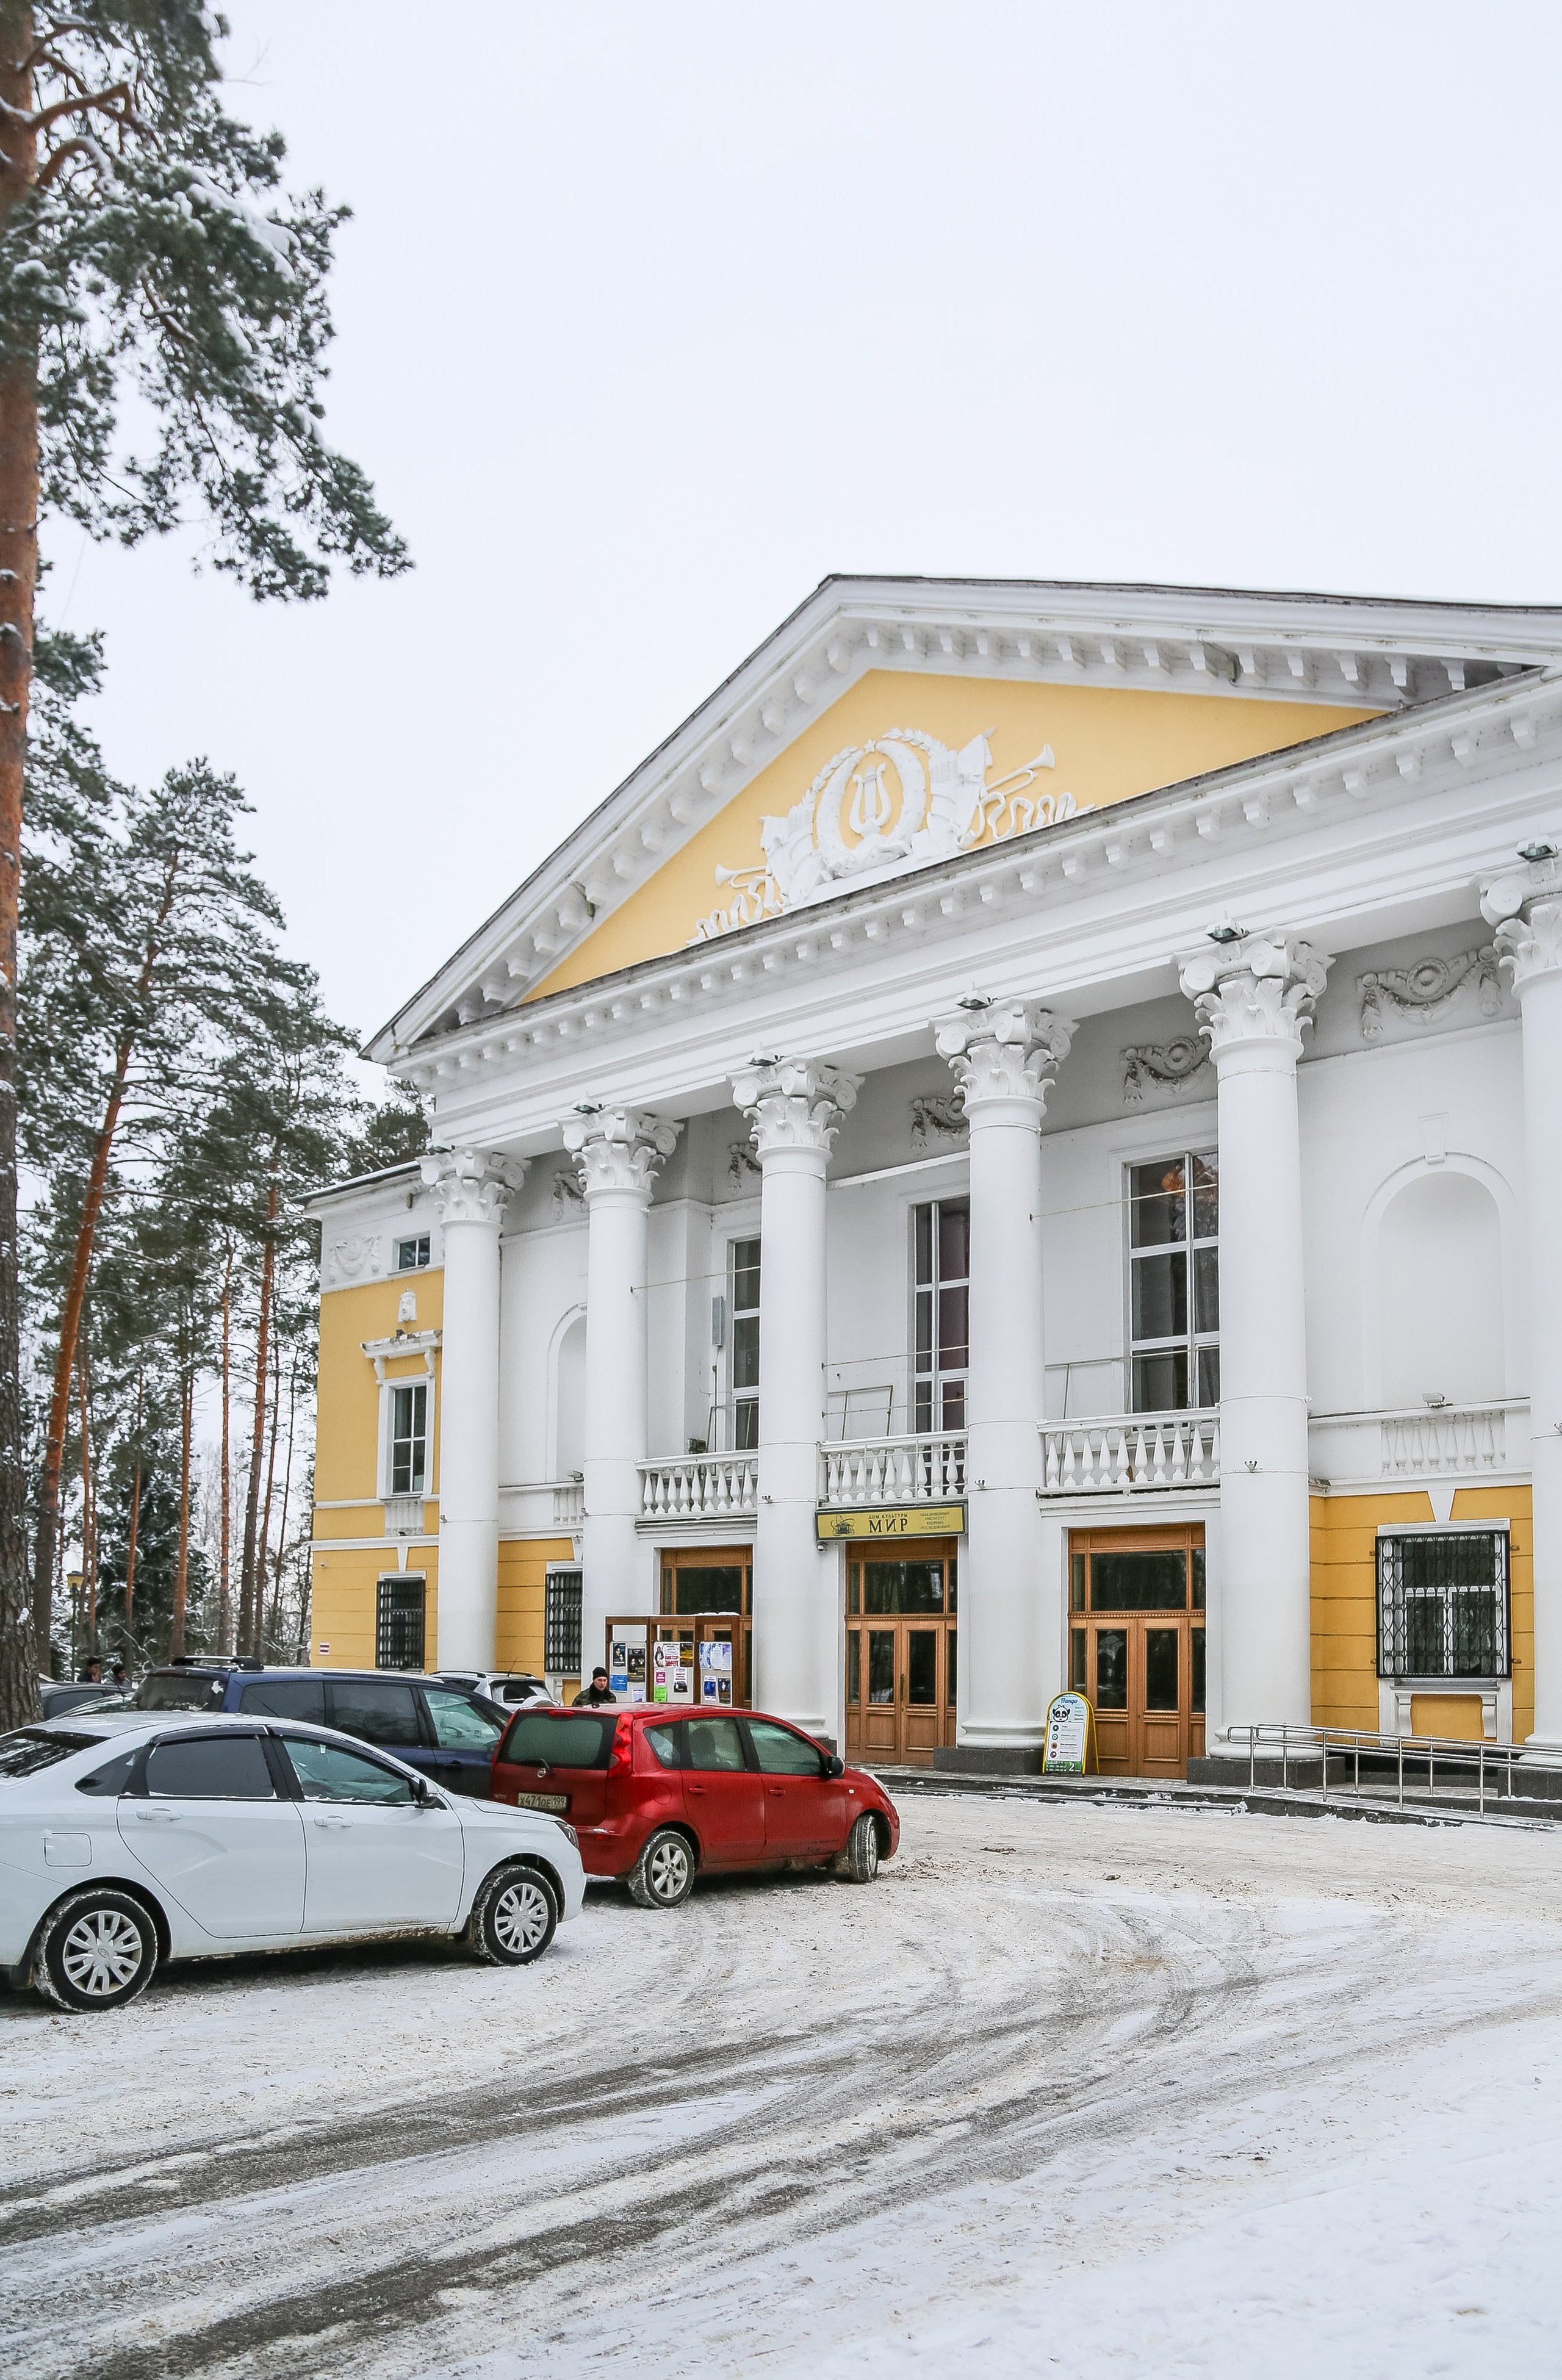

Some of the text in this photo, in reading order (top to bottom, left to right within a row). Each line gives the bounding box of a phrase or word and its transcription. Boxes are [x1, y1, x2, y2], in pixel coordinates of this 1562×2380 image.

[868, 1518, 908, 1533] МИР
[1069, 1762, 1074, 1772] 2
[553, 1797, 565, 1806] 199
